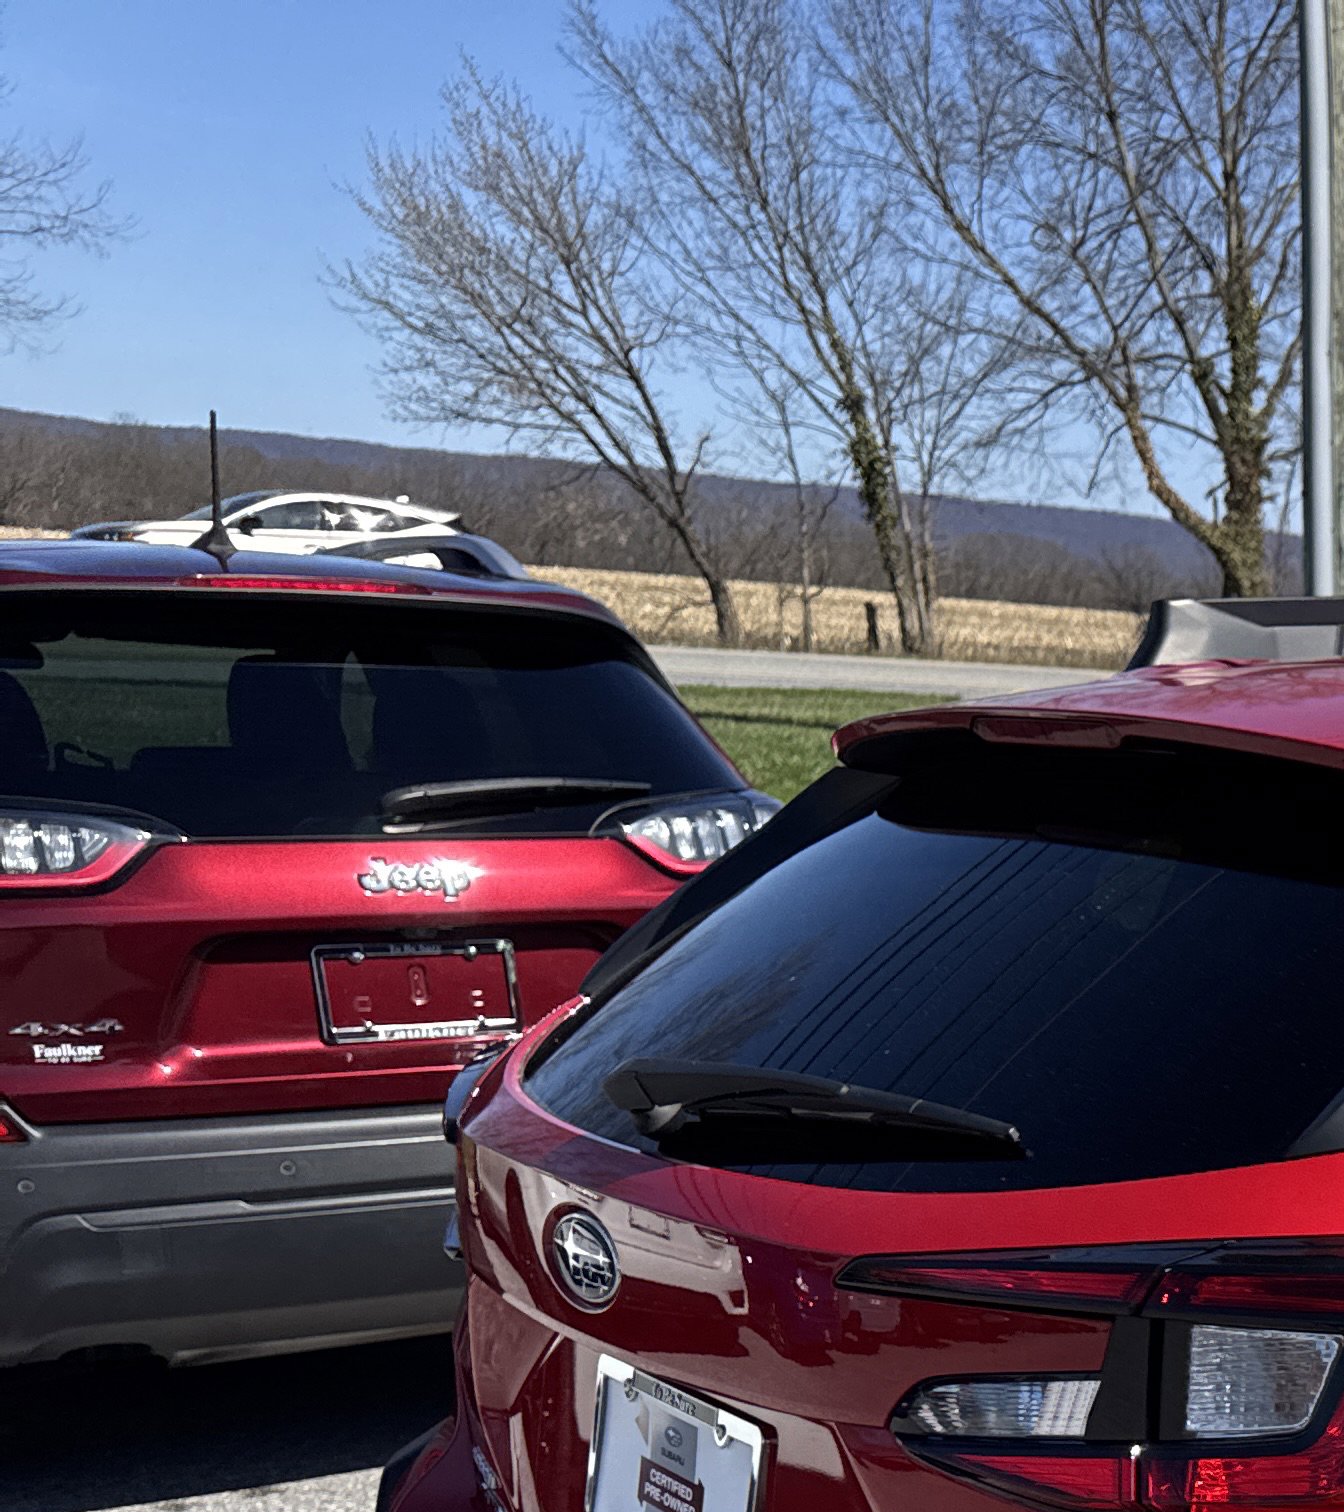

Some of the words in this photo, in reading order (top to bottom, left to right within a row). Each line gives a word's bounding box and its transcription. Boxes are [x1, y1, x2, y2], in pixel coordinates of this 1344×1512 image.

[357, 857, 471, 897] Jeep
[32, 1043, 104, 1058] Faulkner
[661, 1448, 686, 1466] SUBARU
[650, 1468, 693, 1501] CERTIFIED
